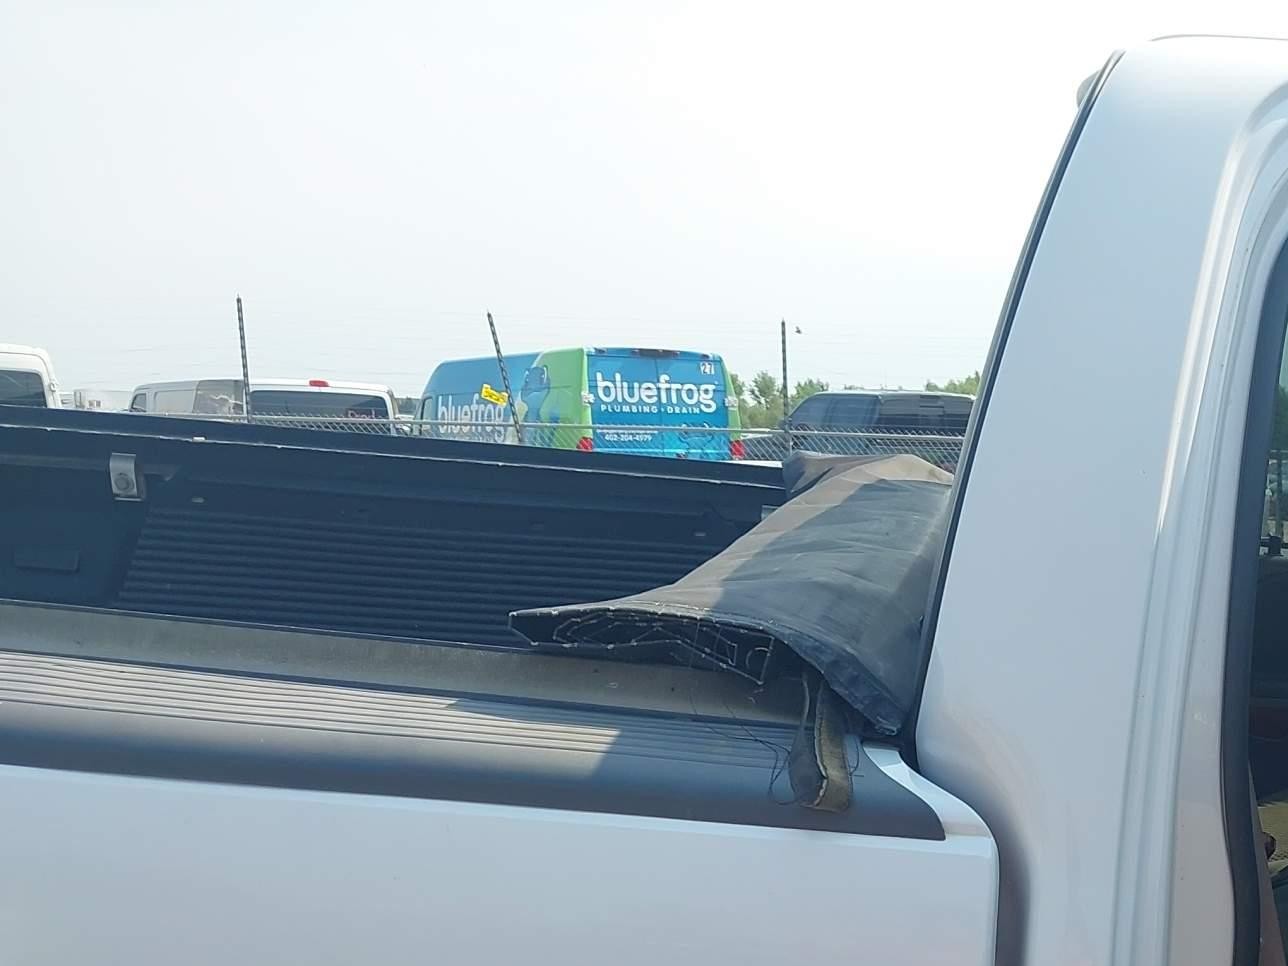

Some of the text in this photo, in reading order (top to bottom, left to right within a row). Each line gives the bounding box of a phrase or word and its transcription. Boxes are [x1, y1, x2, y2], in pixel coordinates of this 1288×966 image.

[596, 371, 717, 413] bluefrog
[600, 404, 700, 415] PLUMBING DRAIN
[438, 393, 505, 443] bluefrog
